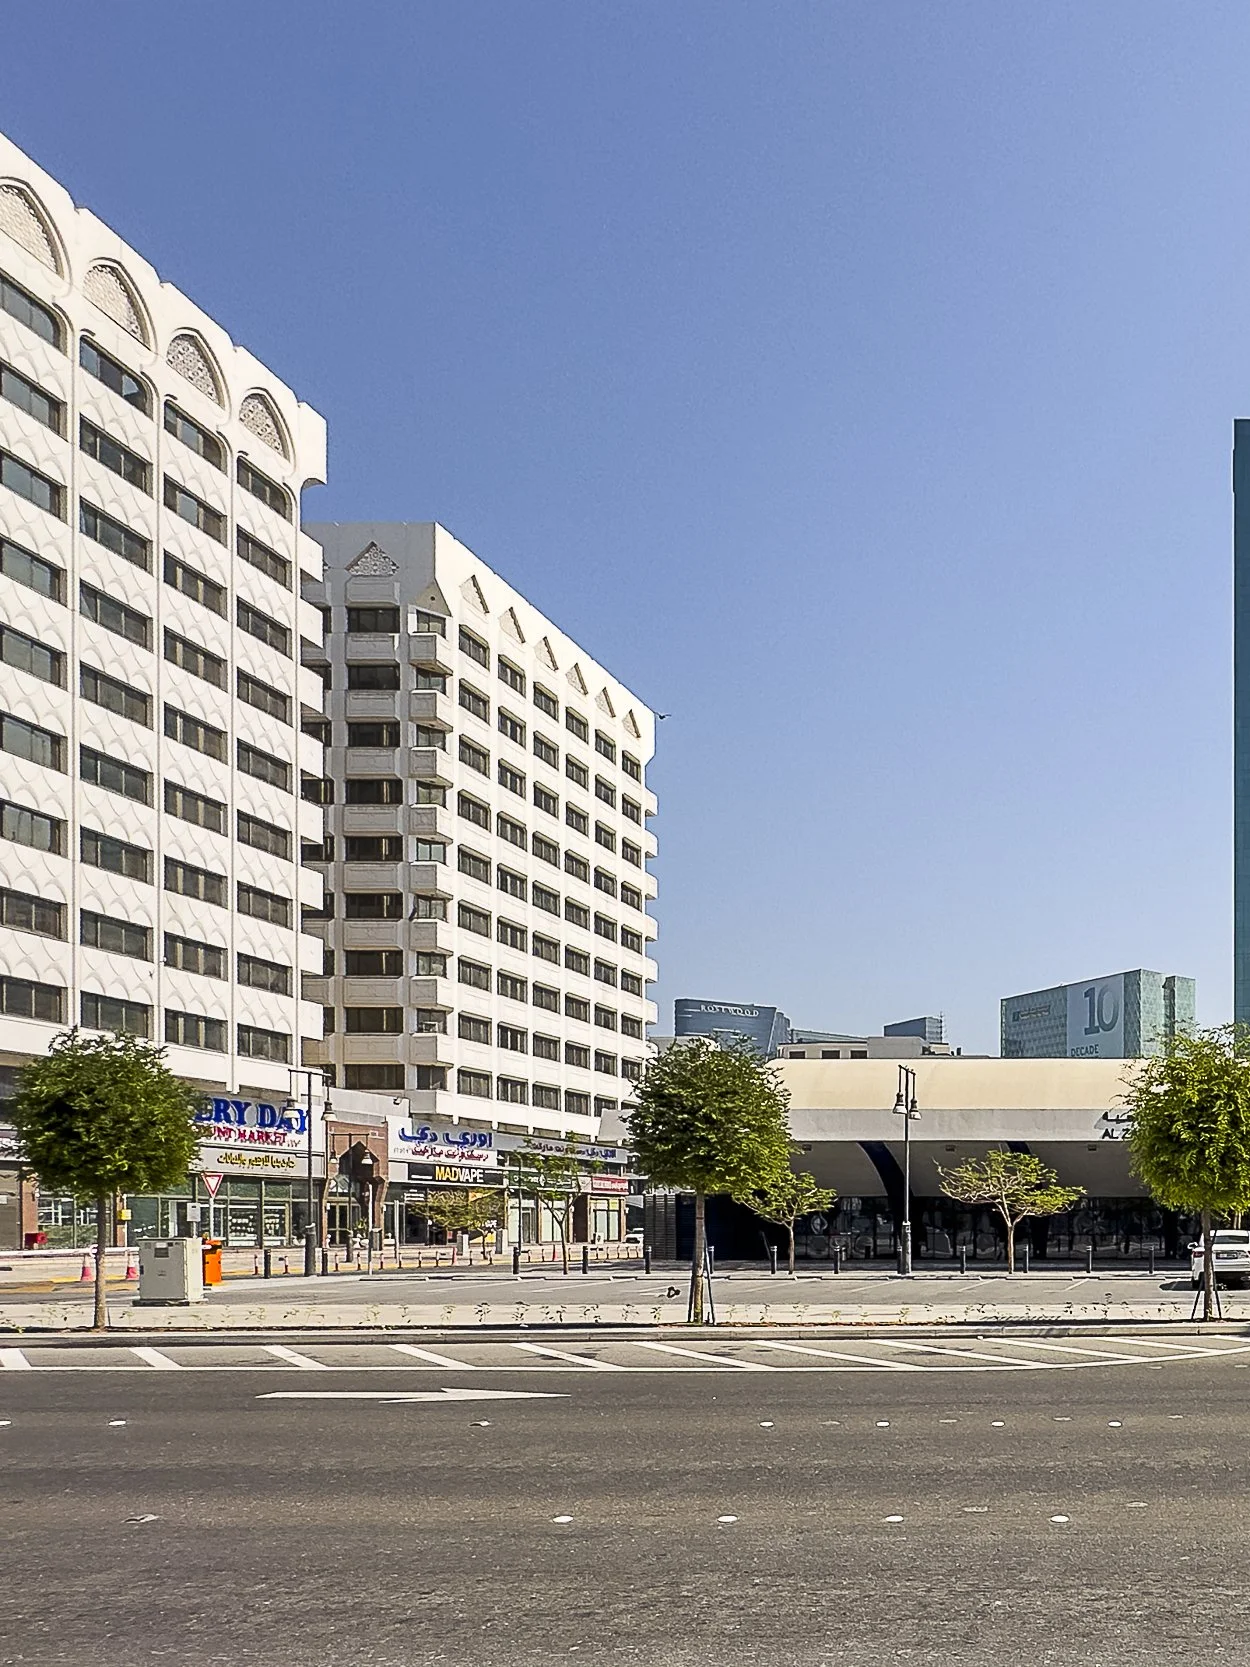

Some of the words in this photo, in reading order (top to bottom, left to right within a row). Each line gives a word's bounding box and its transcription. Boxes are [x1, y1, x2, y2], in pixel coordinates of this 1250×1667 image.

[1083, 986, 1121, 1036] 10
[1071, 1044, 1100, 1057] DECADE
[256, 1103, 307, 1132] DAY
[237, 1129, 287, 1143] MARKET
[1102, 1128, 1119, 1140] AL
[435, 1165, 484, 1183] MADVAPE
